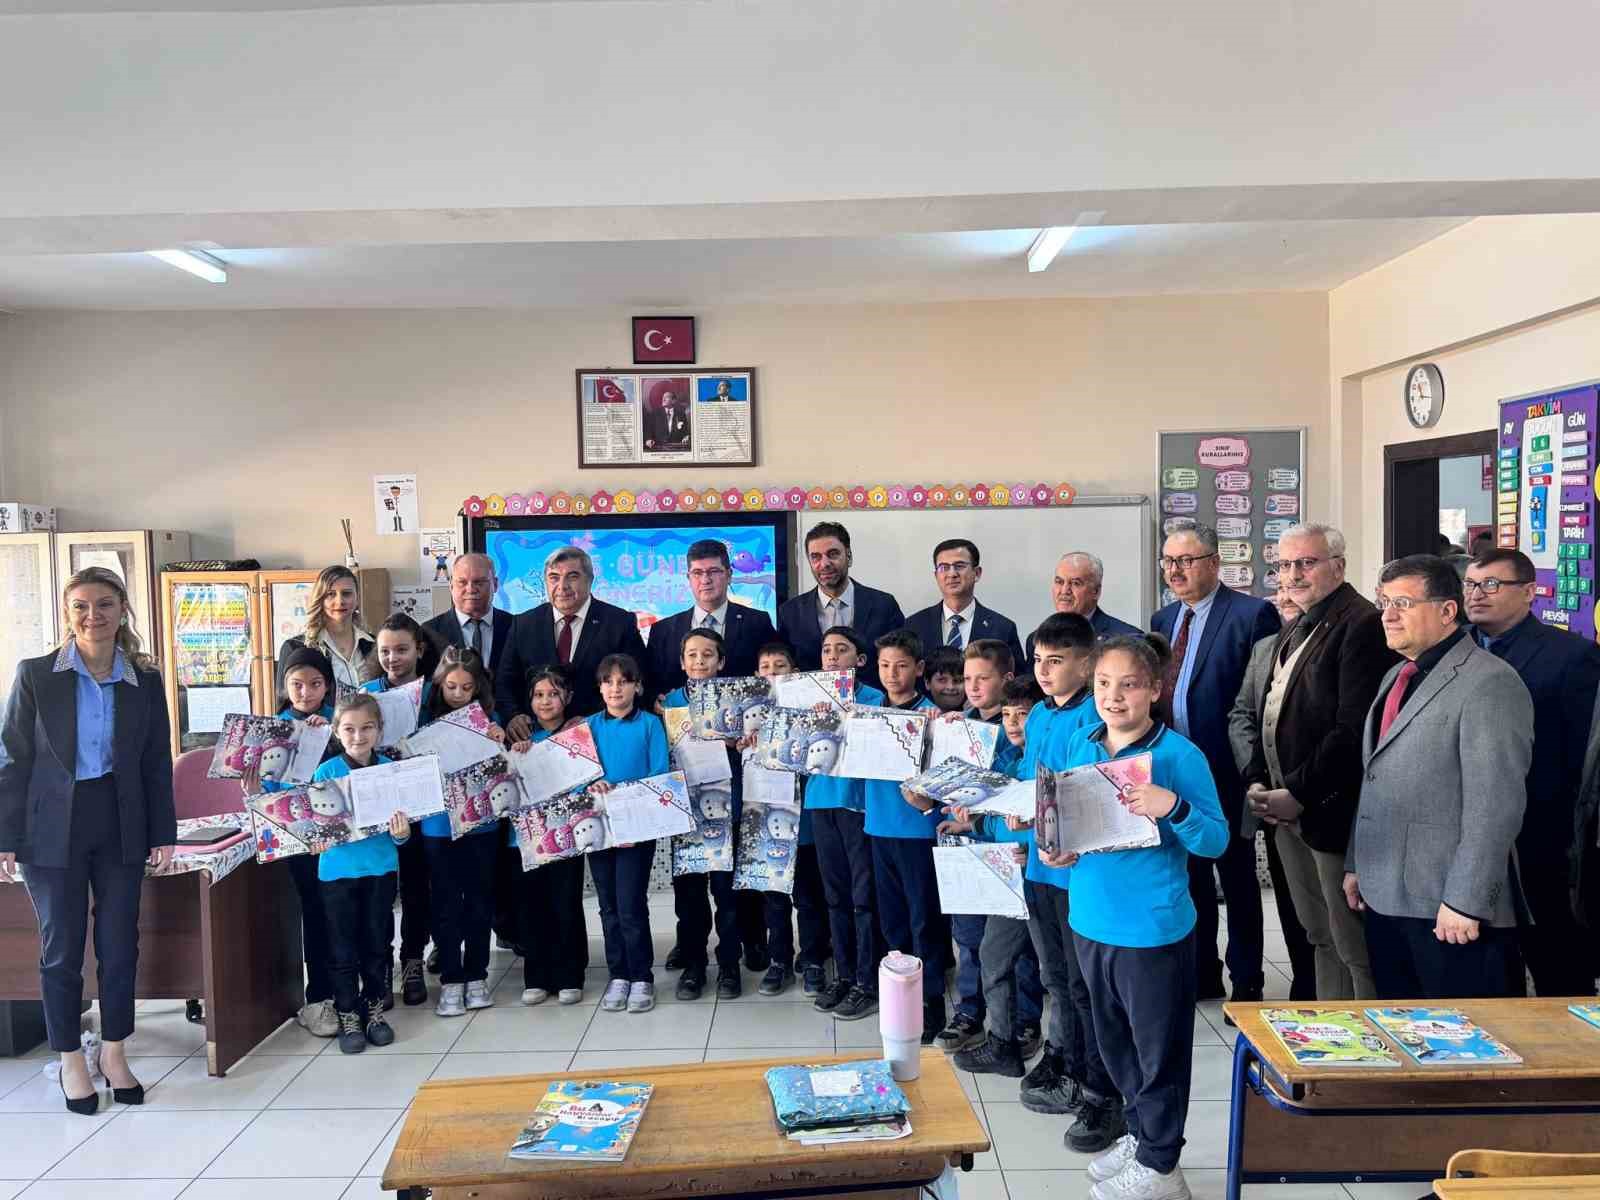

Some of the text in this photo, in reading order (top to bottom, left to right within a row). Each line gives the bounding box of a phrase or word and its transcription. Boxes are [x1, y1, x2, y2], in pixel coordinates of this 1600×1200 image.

[1527, 399, 1561, 418] TAKVİM
[1567, 411, 1586, 427] GÜN
[1562, 525, 1585, 538] TARİH
